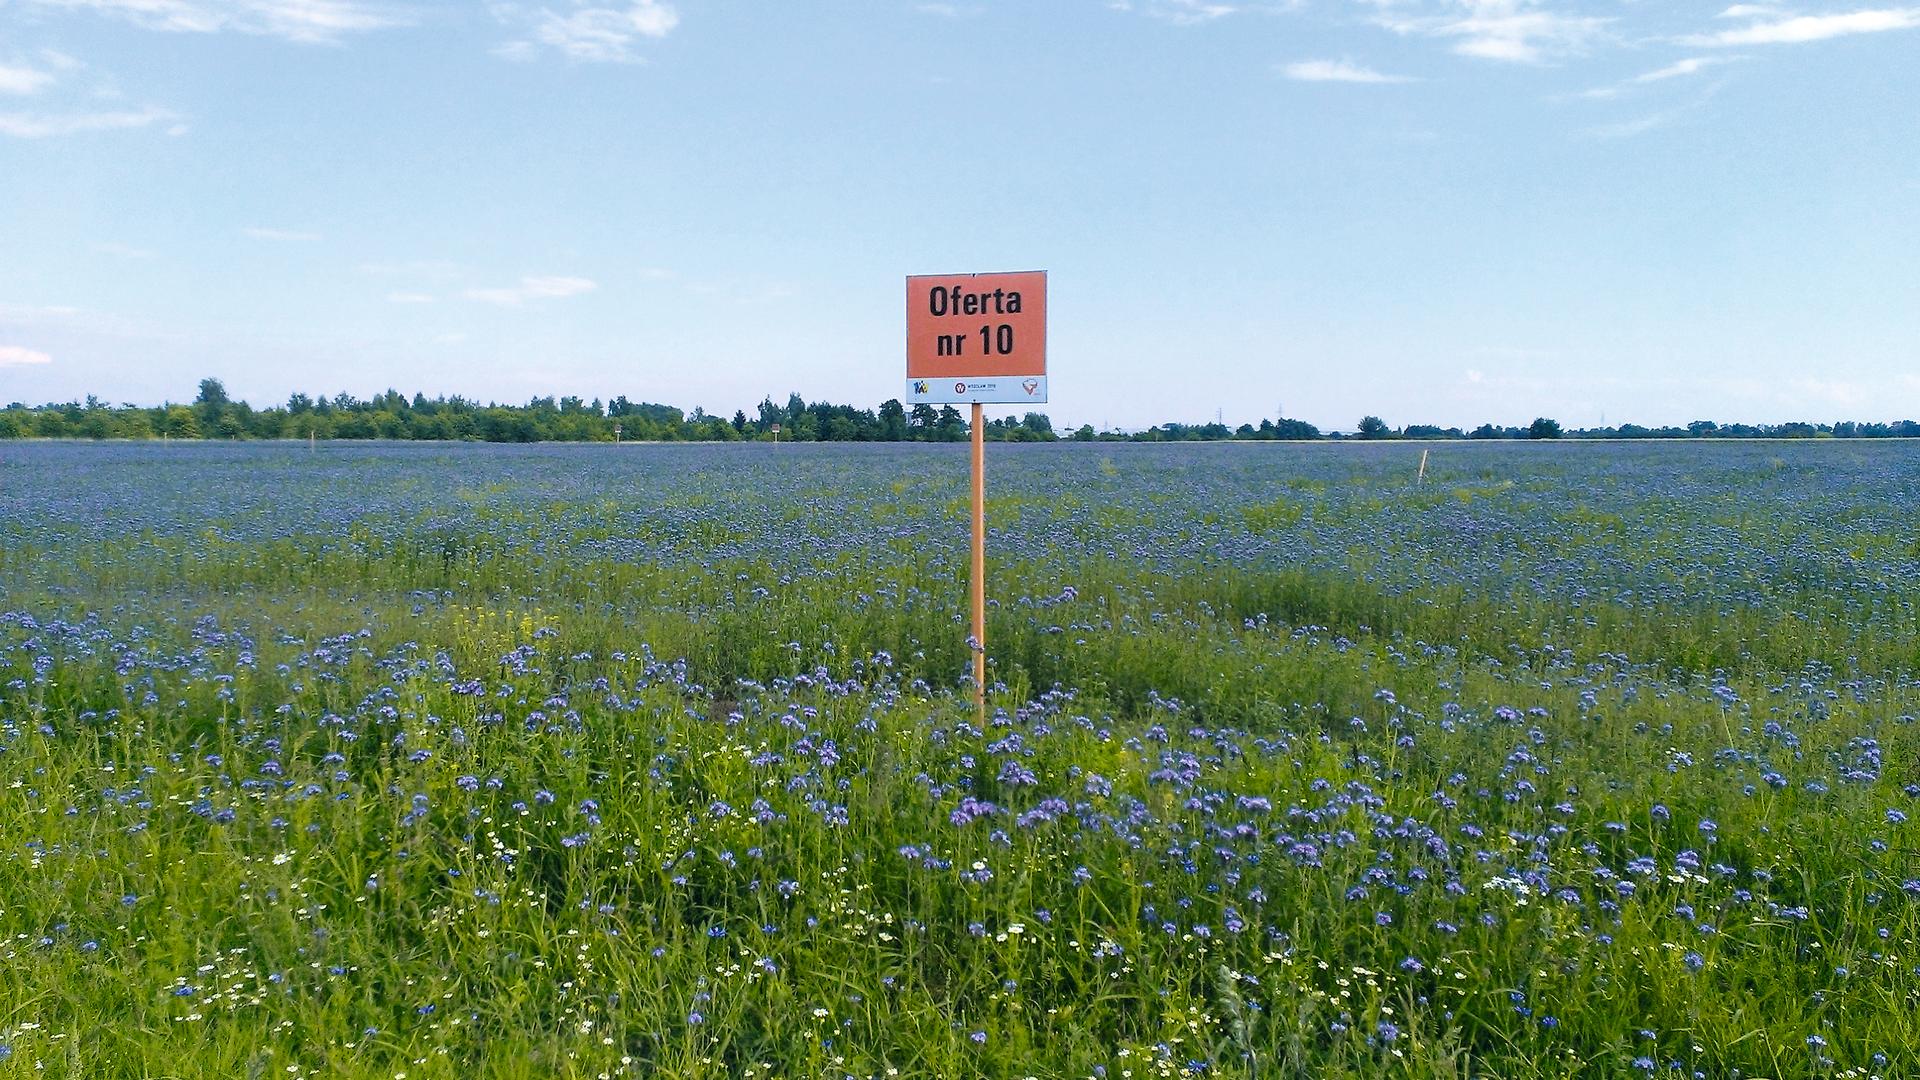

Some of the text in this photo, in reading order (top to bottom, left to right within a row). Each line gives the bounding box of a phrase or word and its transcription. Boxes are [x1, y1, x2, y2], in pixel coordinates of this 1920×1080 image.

[930, 286, 1021, 316] Oferta
[937, 324, 1013, 356] nr 10
